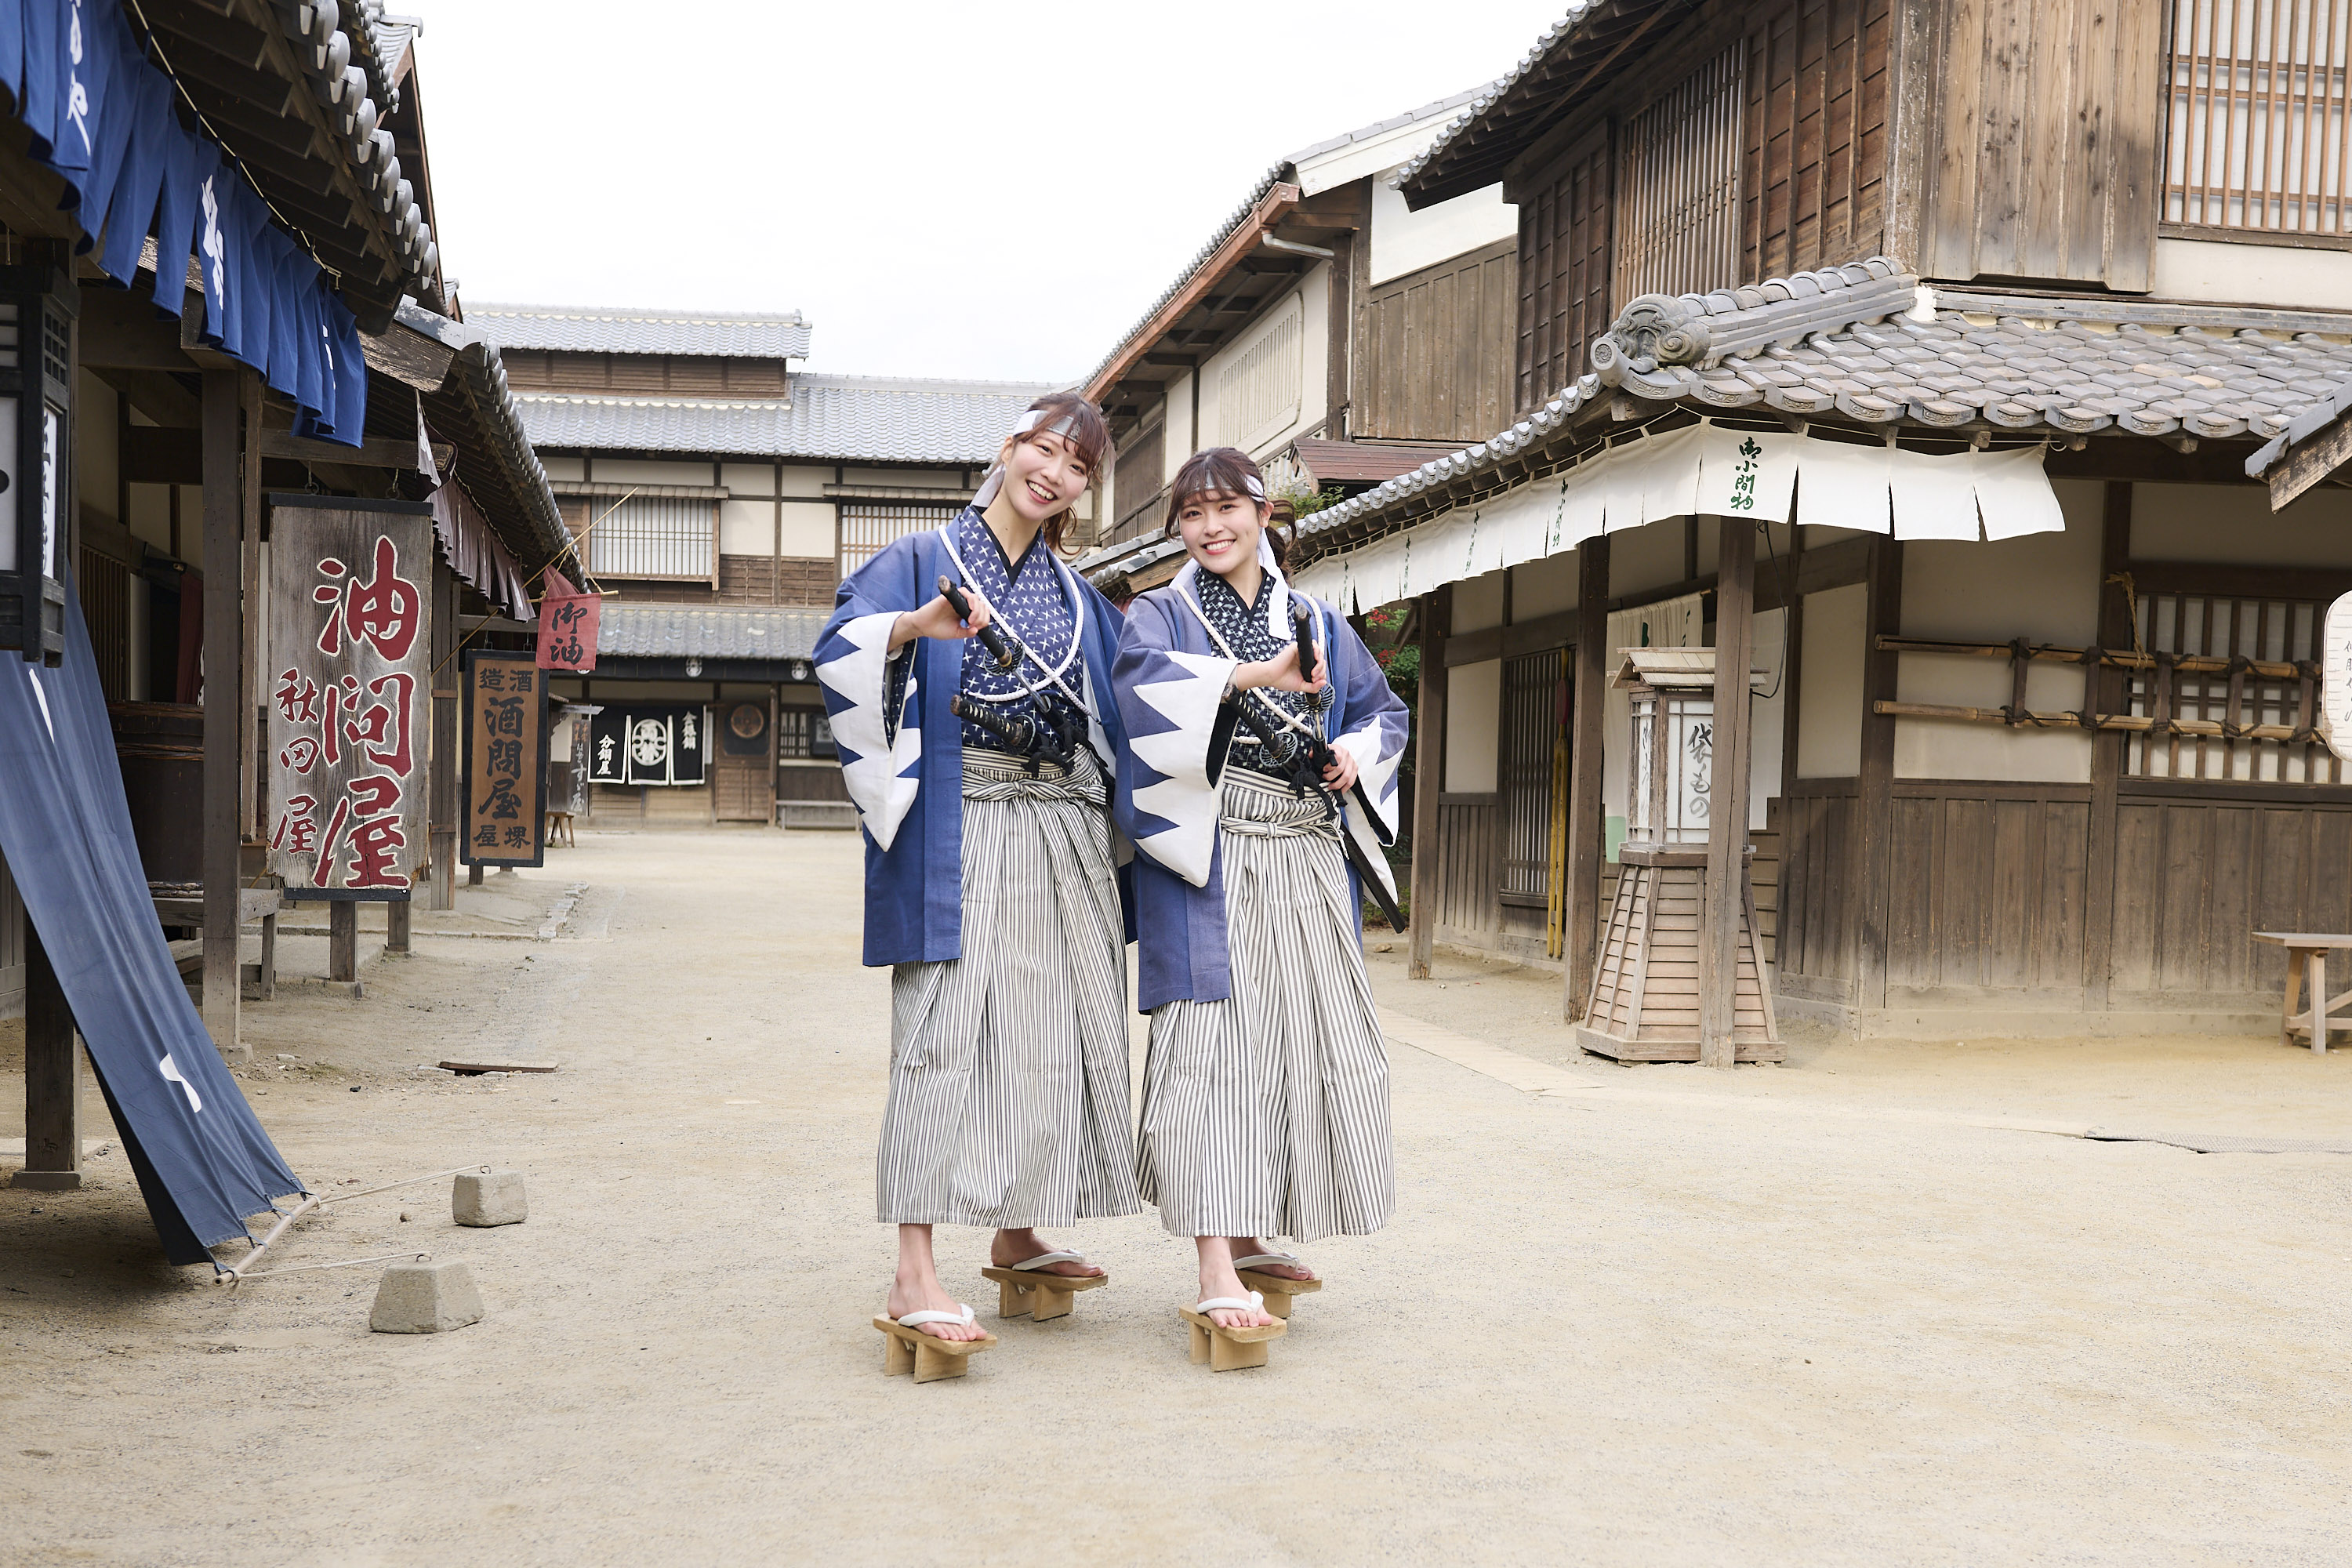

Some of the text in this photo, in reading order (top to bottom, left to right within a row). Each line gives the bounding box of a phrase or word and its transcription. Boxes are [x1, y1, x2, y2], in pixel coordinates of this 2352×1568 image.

[1730, 437, 1762, 510] 御小間物
[550, 601, 587, 665] 御油
[313, 534, 421, 888] 油問屋
[477, 695, 524, 820] 酒問屋
[597, 734, 616, 775] 分銅屋
[270, 668, 321, 854] 秋田屋
